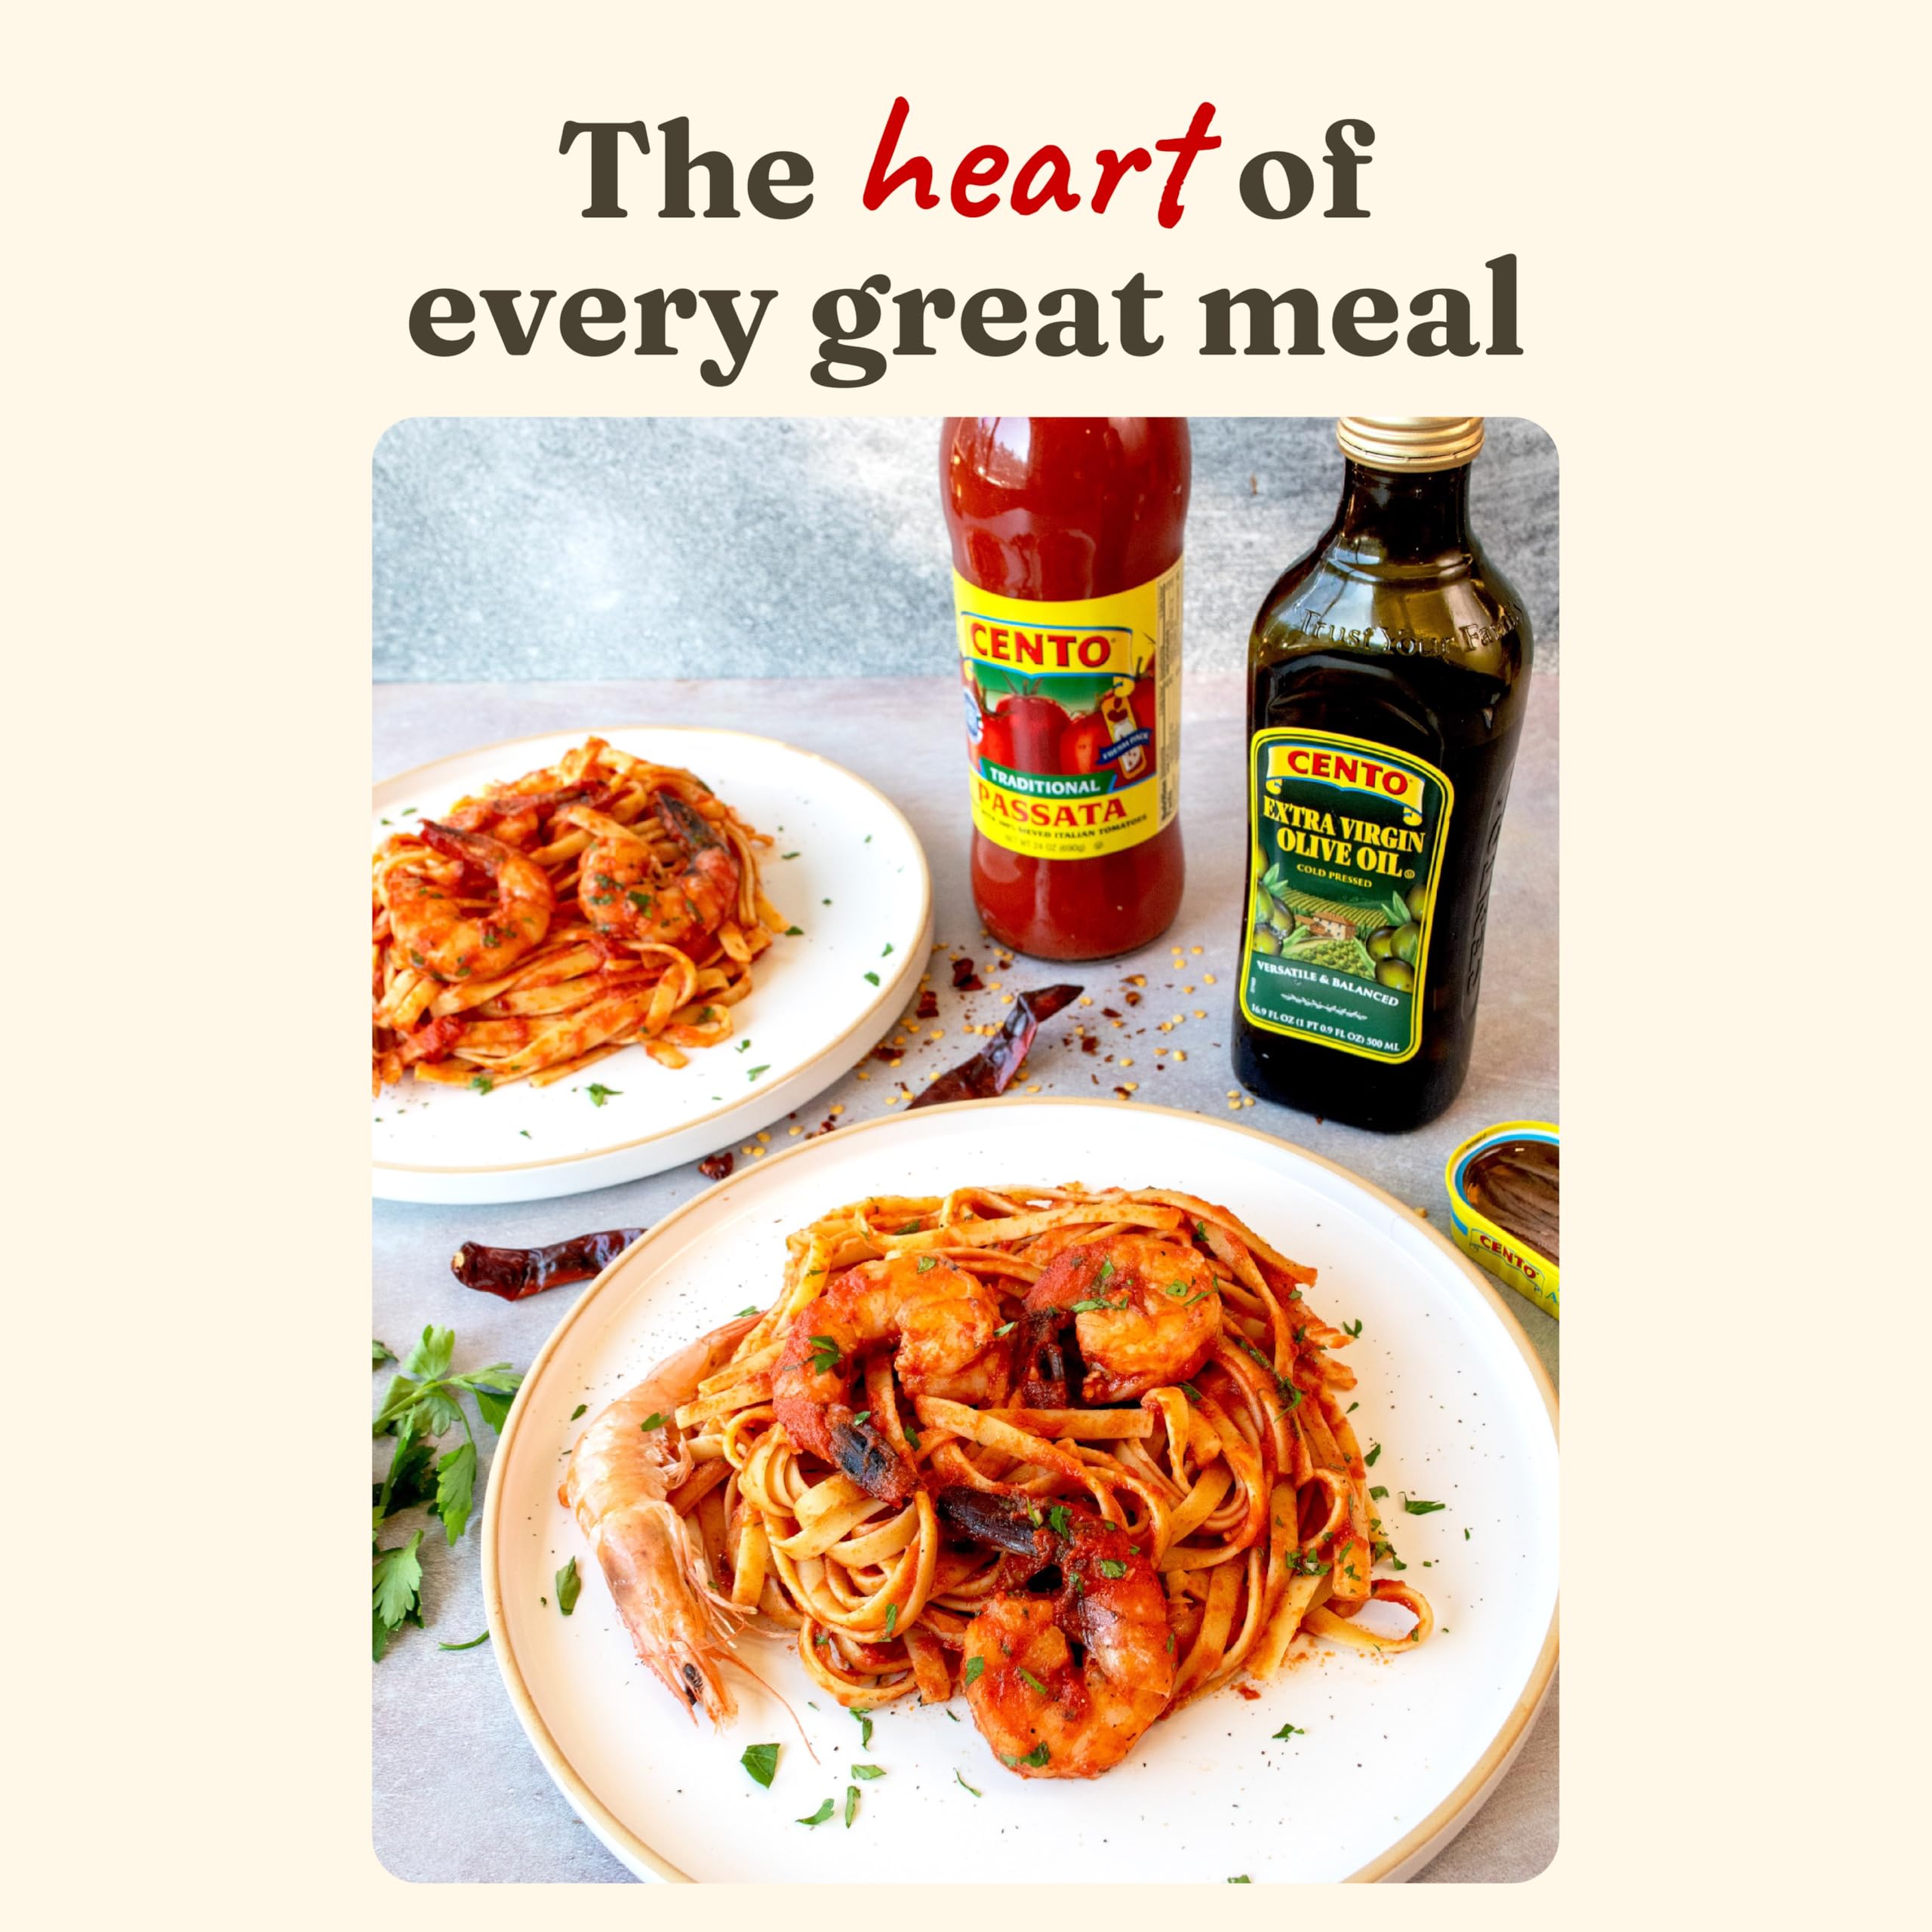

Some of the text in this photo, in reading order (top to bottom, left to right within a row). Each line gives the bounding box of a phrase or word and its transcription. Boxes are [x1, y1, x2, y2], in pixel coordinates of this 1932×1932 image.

[971, 623, 1111, 668] CENTO
[1300, 608, 1374, 651] Trust
[1380, 627, 1455, 657] Your
[989, 767, 1101, 795] TRADITIONAL
[1287, 750, 1408, 795] CENTO
[978, 780, 1128, 828] PASSATA
[1054, 830, 1096, 839] ITALIAN
[1099, 813, 1147, 835] TOMATOES
[1263, 795, 1426, 854] EXTRA VIRGIN
[1277, 827, 1402, 878] OLIVE OIL
[1296, 863, 1372, 888] COLD PRESSED
[1257, 960, 1399, 1007] VERSATILE & BALANCED
[1251, 1004, 1400, 1052] 16.9 FL OZ (1 PT 0.9 FL OZ) 500 ML
[1480, 1235, 1537, 1279] CENTO
